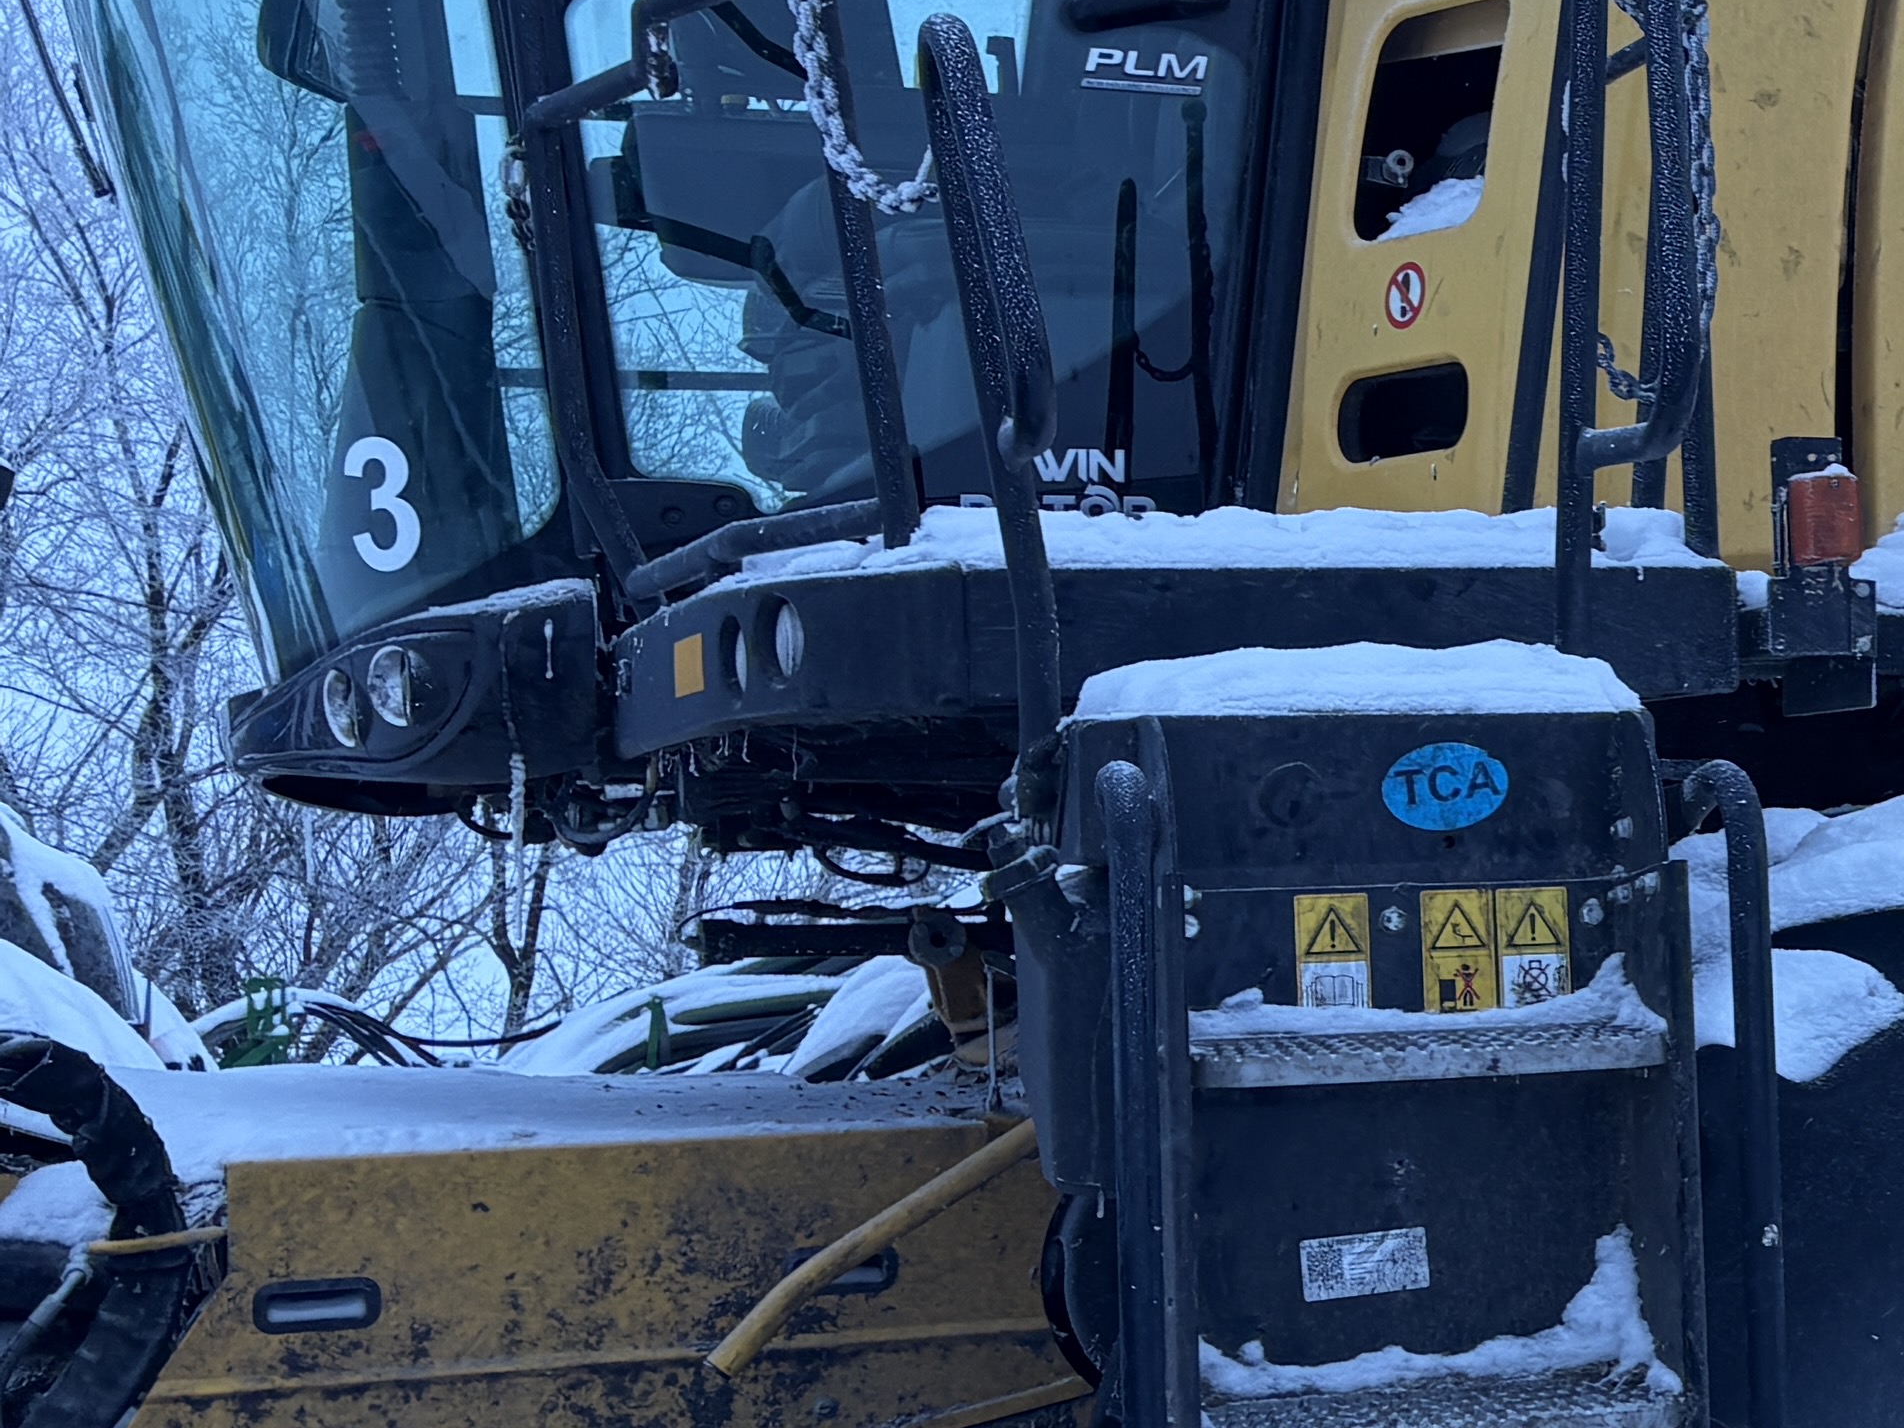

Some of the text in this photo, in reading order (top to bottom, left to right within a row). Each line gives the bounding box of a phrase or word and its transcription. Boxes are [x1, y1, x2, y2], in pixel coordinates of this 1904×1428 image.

[1083, 46, 1210, 81] PLM
[1032, 447, 1127, 484] WIN
[342, 435, 423, 574] 3
[1393, 760, 1501, 807] TCA
